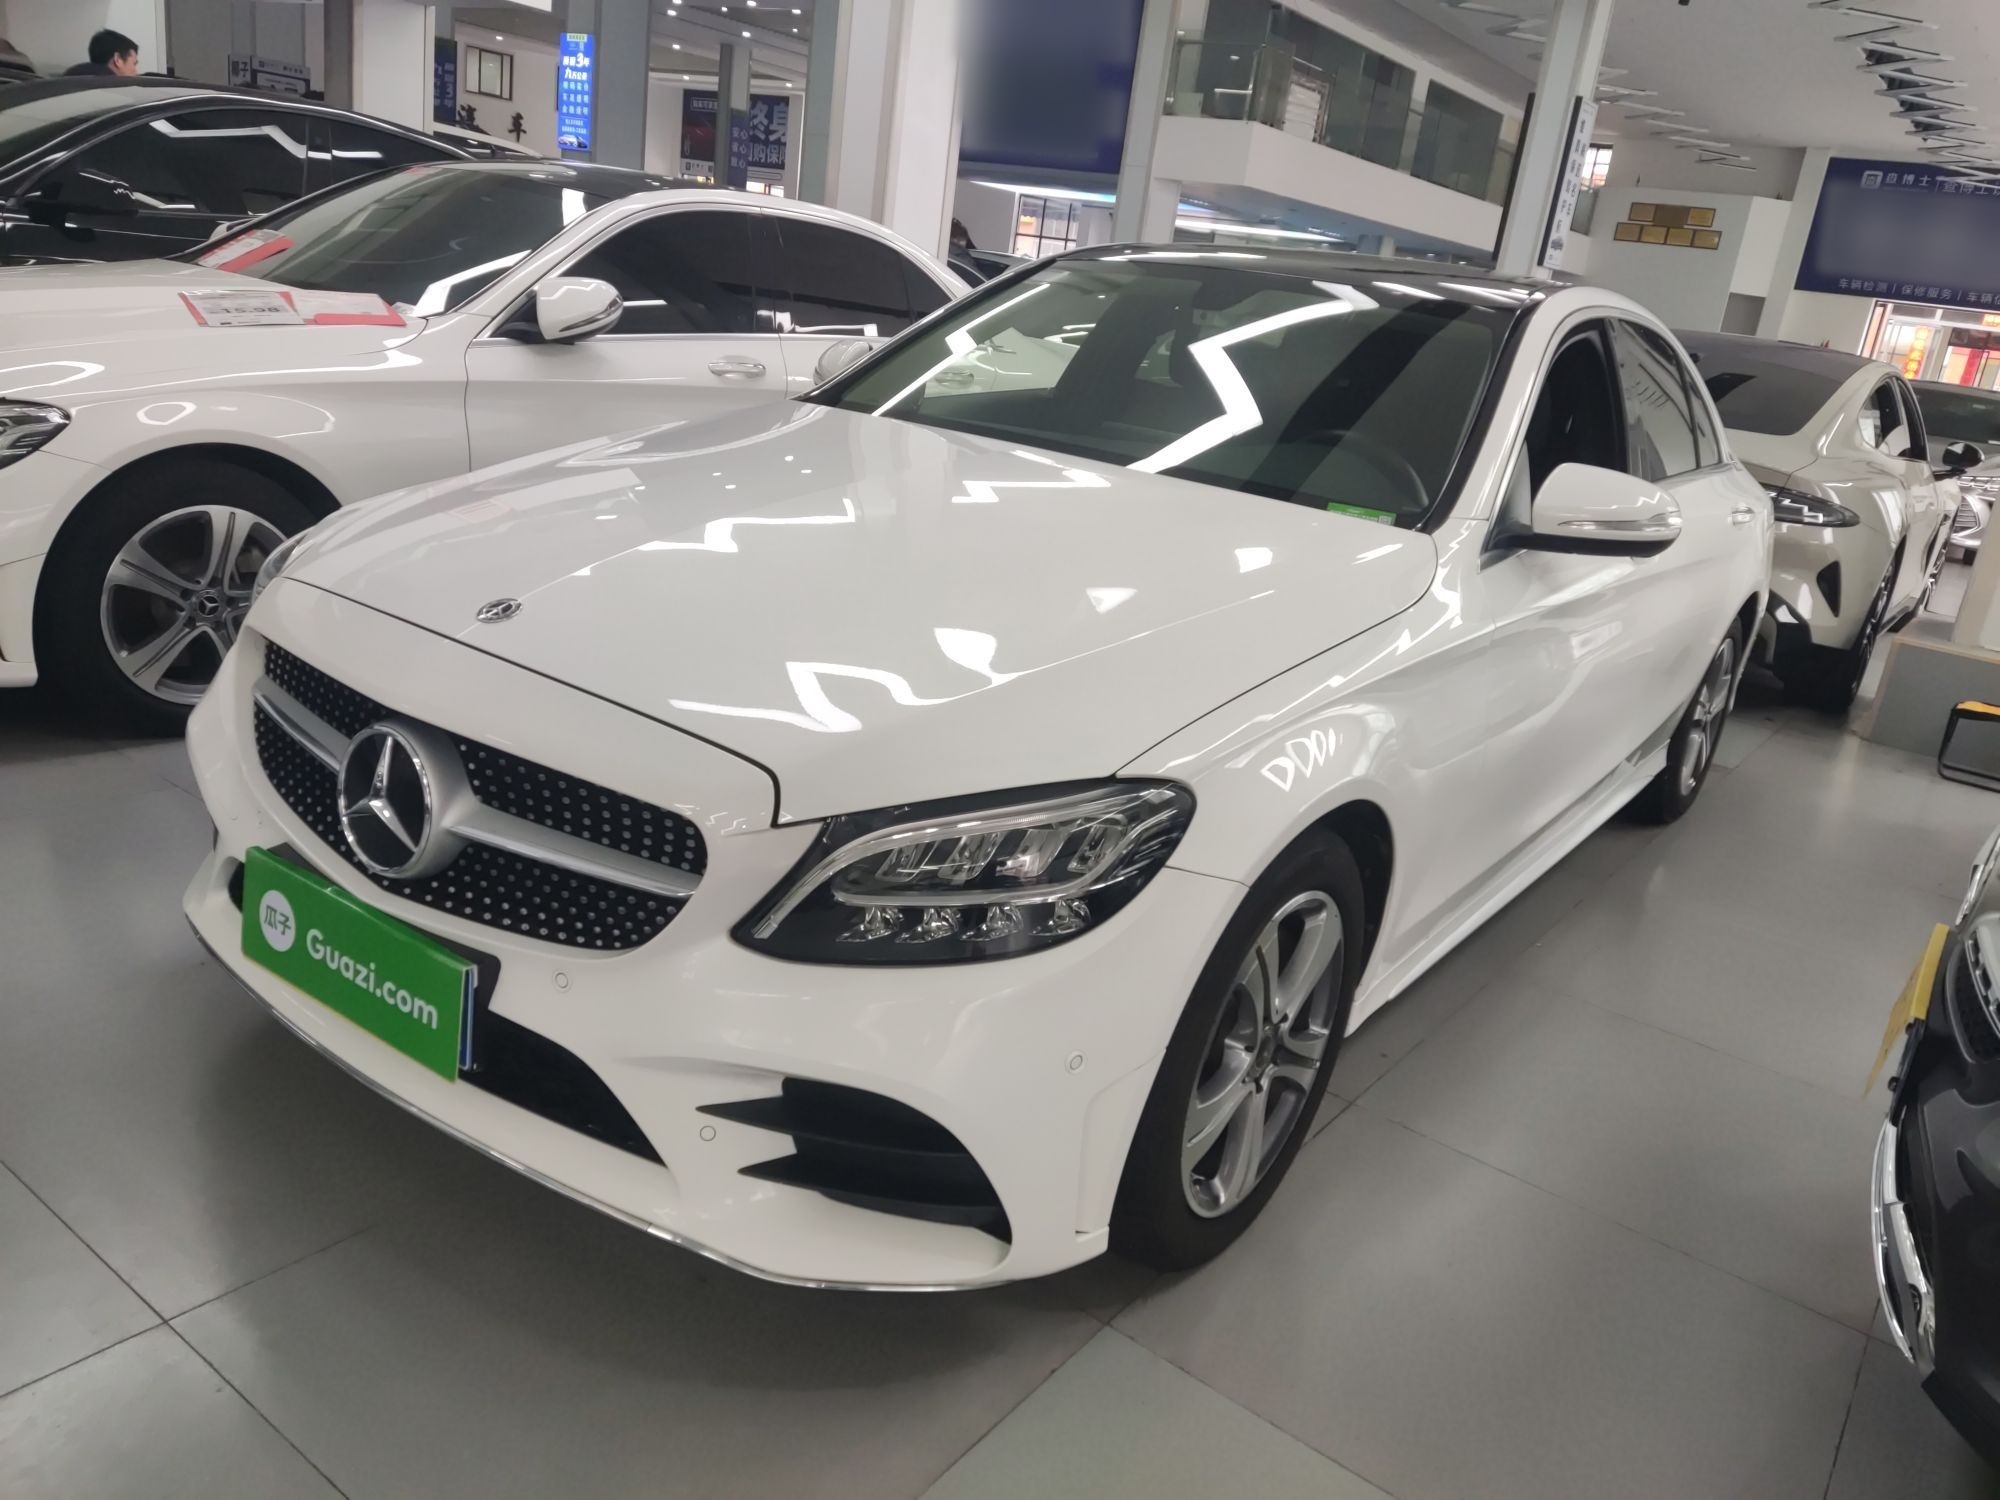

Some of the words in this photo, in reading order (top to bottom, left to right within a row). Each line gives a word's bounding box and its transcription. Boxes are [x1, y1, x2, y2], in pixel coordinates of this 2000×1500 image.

[1838, 278, 1888, 293] 车辆检测
[1902, 284, 1954, 300] 保修服务
[262, 904, 292, 936] 瓜子
[305, 928, 438, 1030] Guazi.com
